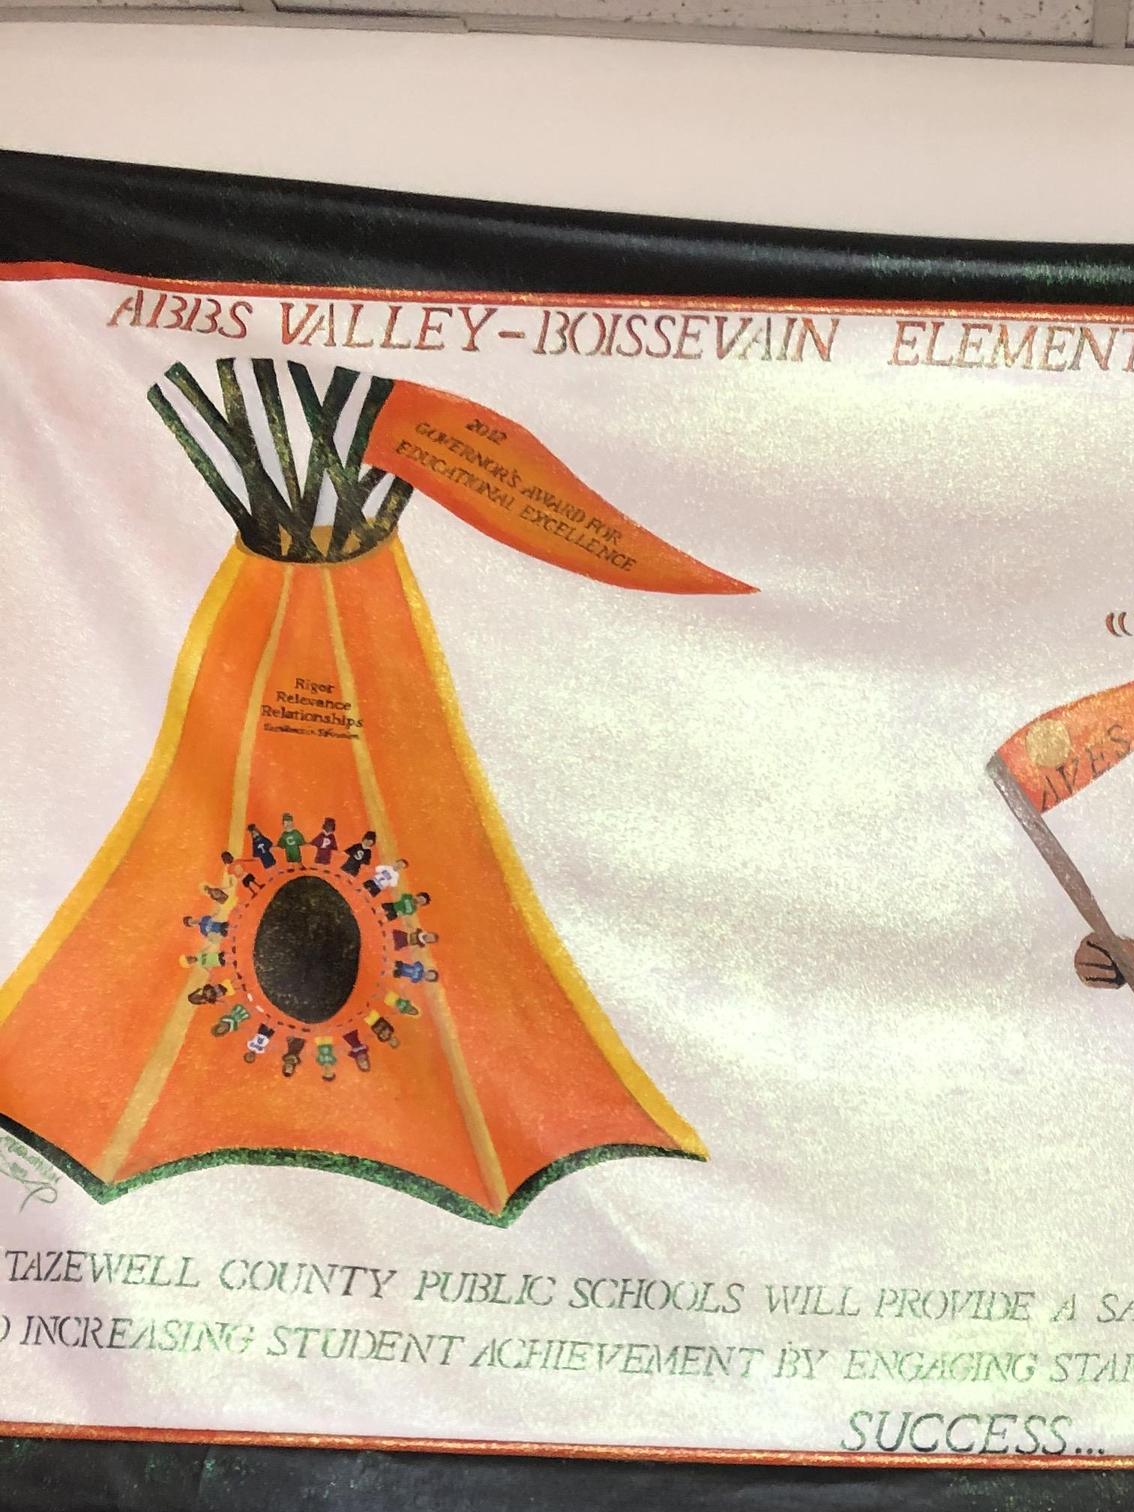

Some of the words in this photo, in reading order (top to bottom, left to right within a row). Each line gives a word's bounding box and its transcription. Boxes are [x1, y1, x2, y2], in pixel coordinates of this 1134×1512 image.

[108, 290, 254, 339] ABBS
[466, 419, 508, 445] 2012
[396, 440, 514, 512] EDUCATIONAL
[519, 505, 638, 573] EXCELLENCE
[415, 423, 522, 488] GOVERNOR'S
[521, 485, 586, 524] AWARD
[584, 515, 622, 546] FOR
[275, 690, 352, 711] Relevance
[295, 677, 335, 695] Rigor
[261, 704, 364, 730] Relationships
[286, 836, 296, 846] C
[321, 837, 331, 849] P
[4, 1249, 200, 1289] TAZEWELL
[218, 1257, 398, 1300] COUNTY
[414, 1269, 557, 1307] PUBLIC
[568, 1276, 745, 1315] SCHOOLS
[765, 1284, 861, 1318] WILL
[874, 1287, 1036, 1322] PROVIDE
[1052, 1293, 1078, 1323] A
[19, 1313, 255, 1355] INCREASING
[266, 1325, 464, 1367] STUDENT
[469, 1337, 765, 1379] ACHIEVEMENT
[773, 1346, 828, 1381] BY
[843, 1348, 1038, 1384] ENGAGING
[840, 1409, 1106, 1457] SUCCESS...
